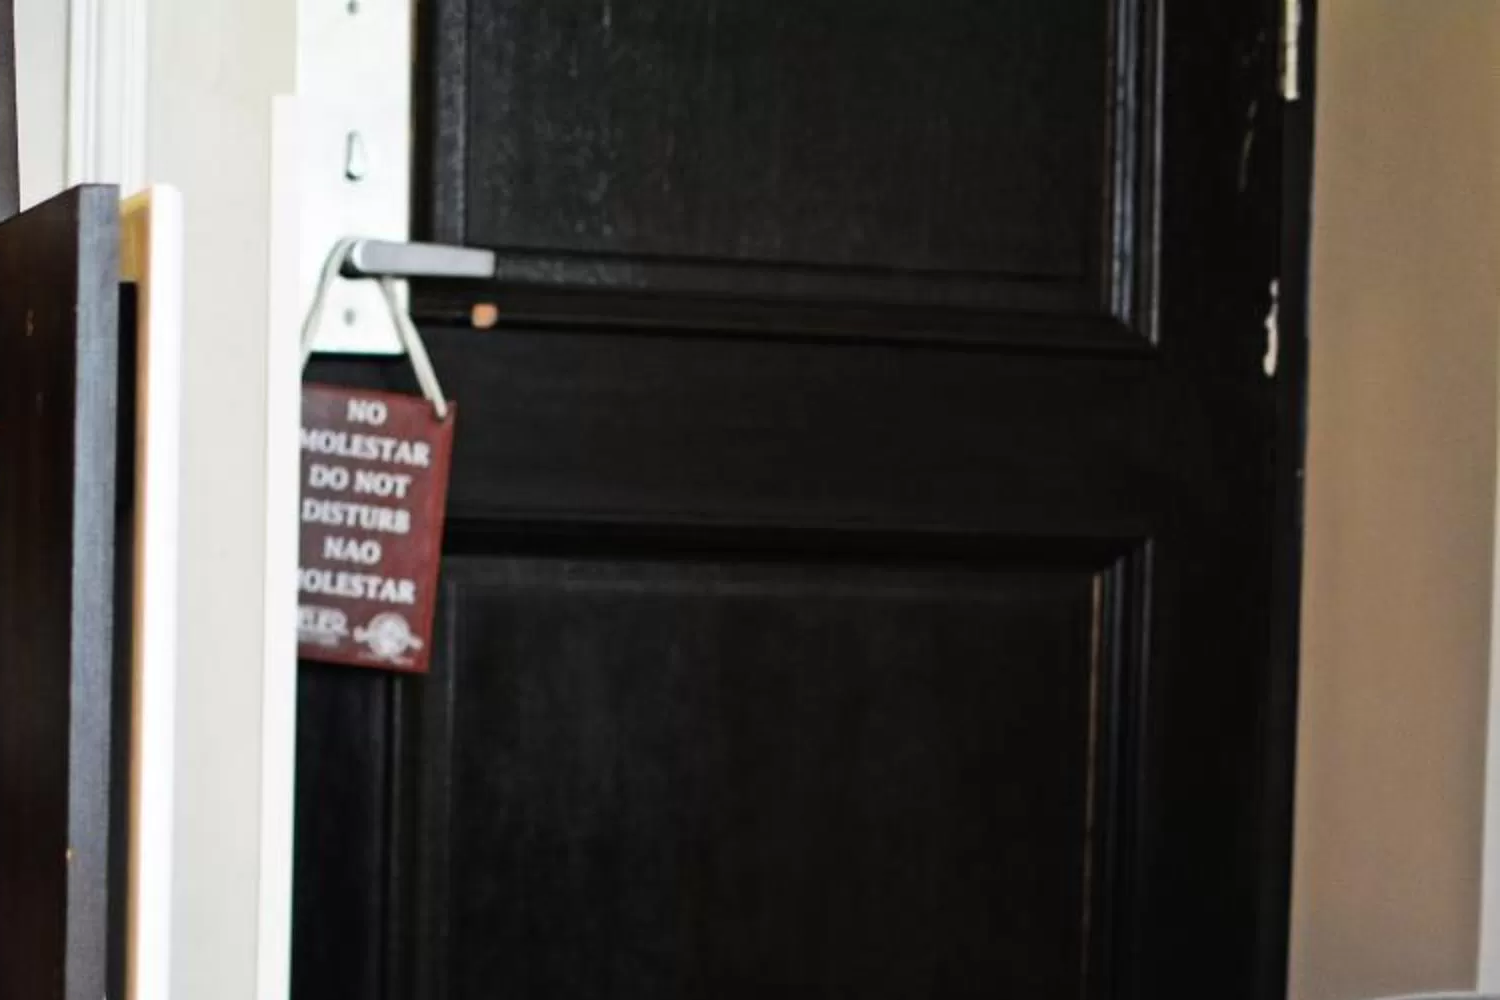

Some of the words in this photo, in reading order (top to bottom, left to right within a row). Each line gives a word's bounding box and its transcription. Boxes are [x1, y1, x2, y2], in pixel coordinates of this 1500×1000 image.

[347, 399, 388, 426] NO
[309, 464, 349, 491] DO
[354, 471, 412, 499] NOT
[301, 497, 411, 533] DISTURB
